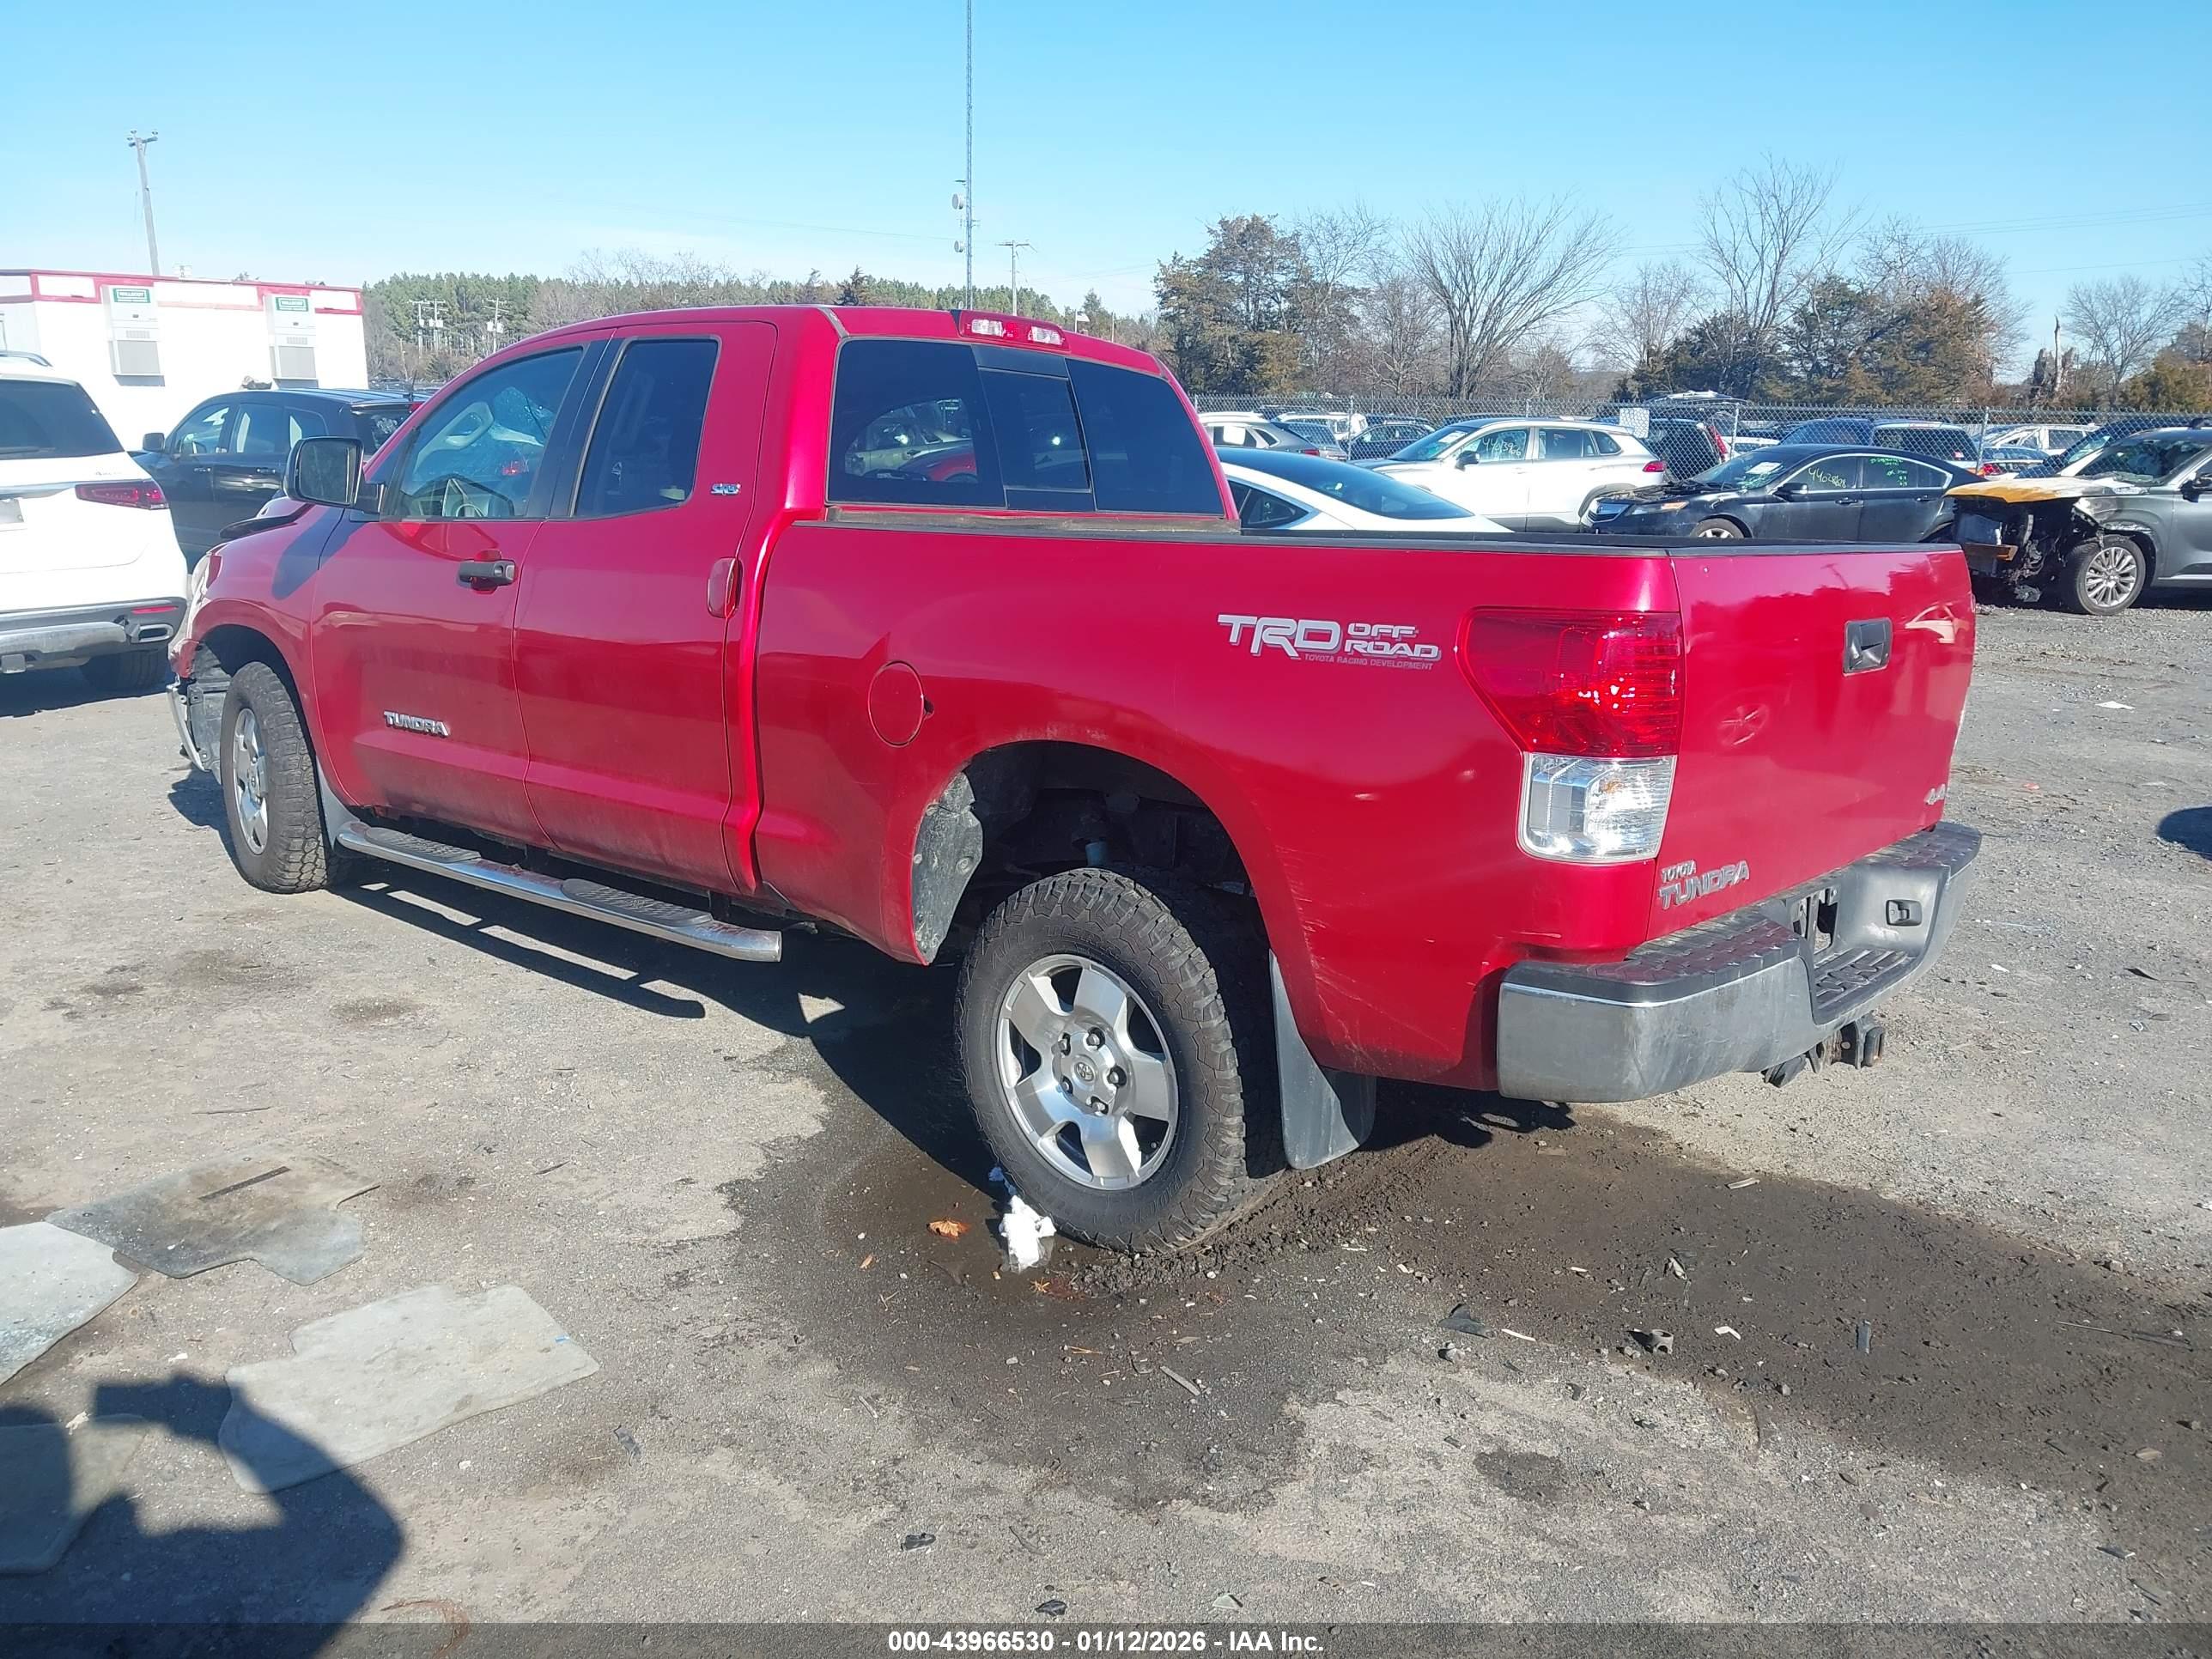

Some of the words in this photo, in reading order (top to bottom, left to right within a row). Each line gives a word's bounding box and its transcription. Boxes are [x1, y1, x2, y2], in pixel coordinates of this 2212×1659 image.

[1217, 613, 1342, 660] TRD
[1346, 623, 1419, 640] OFF
[1304, 653, 1334, 663] TOYOTA
[1337, 656, 1368, 665] RACING
[1370, 659, 1434, 671] DEVELOPMENT
[1344, 640, 1442, 661] ROAD
[383, 709, 451, 738] TUNDRA
[1662, 859, 1696, 884] TOYOTA
[1658, 860, 1750, 910] TUNDRA
